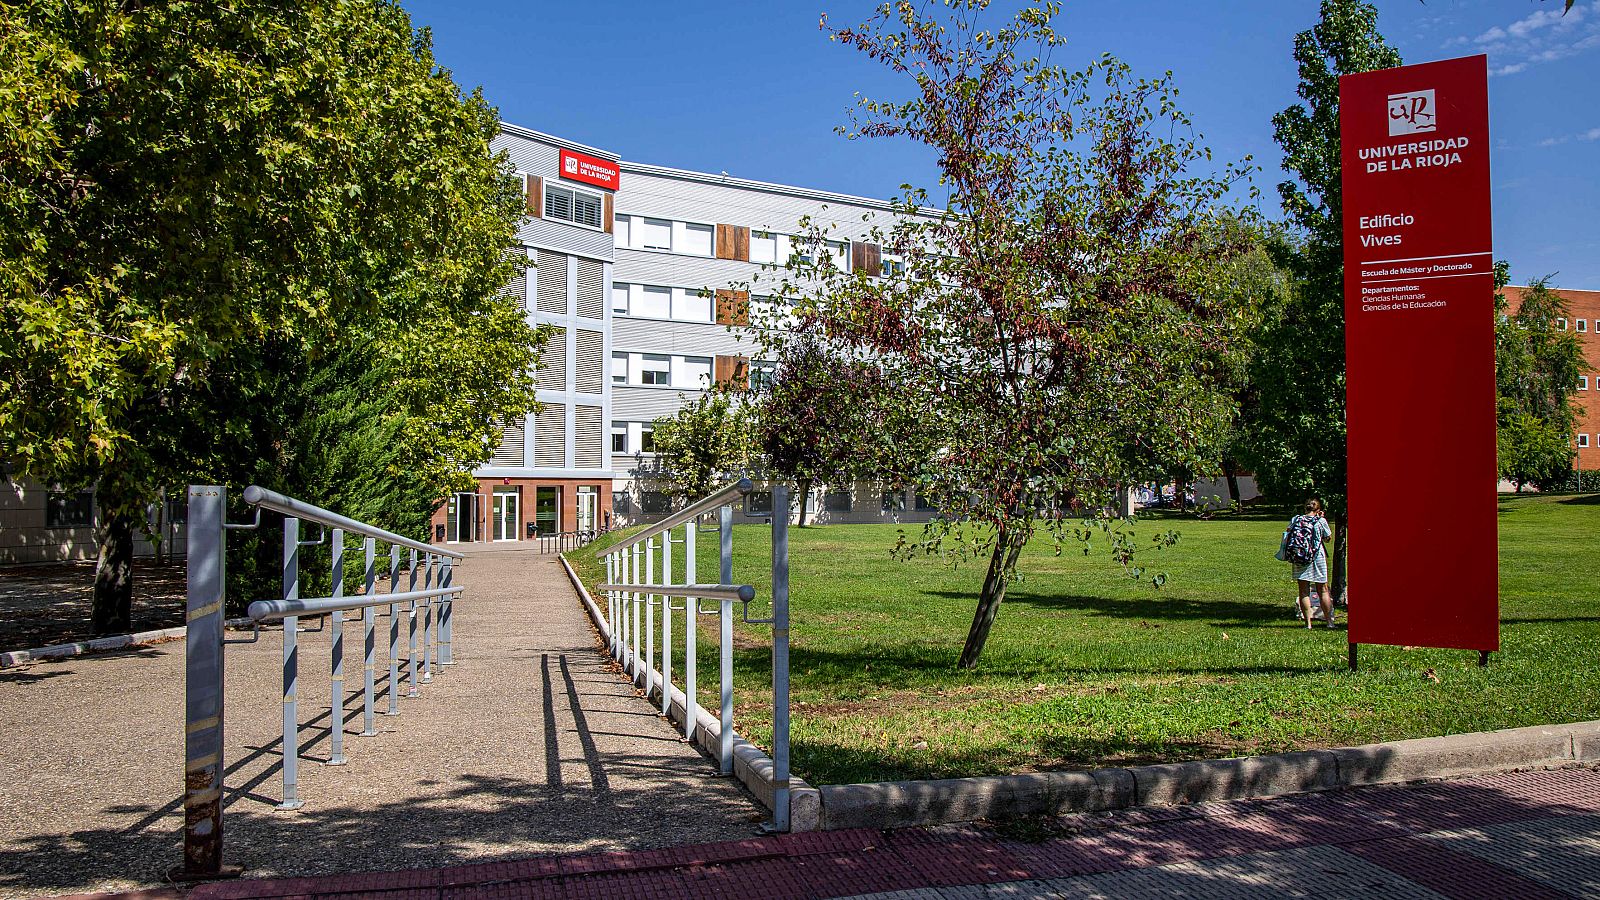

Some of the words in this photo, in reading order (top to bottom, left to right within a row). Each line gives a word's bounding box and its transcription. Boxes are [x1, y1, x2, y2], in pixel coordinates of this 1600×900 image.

[1359, 137, 1469, 160] UNIVERSIDAD
[580, 162, 616, 176] UNIVERSIDAD
[1366, 161, 1387, 173] DE
[1391, 158, 1412, 171] LA
[1415, 152, 1462, 168] RIOJA
[580, 168, 587, 176] DE
[588, 170, 596, 178] LA
[596, 172, 611, 181] RIOJA
[1360, 213, 1414, 229] Edificio
[1360, 234, 1402, 248] Vives
[1361, 268, 1389, 277] Escuela
[1390, 267, 1399, 275] de
[1400, 265, 1426, 275] Máster
[1433, 262, 1473, 272] Doctorado
[1361, 285, 1420, 295] Departamentos:
[1362, 294, 1391, 303] Ciencias
[1391, 293, 1426, 301] Humanas
[1362, 303, 1391, 312] Ciencias
[1392, 302, 1401, 310] de
[1409, 300, 1447, 309] Educación
